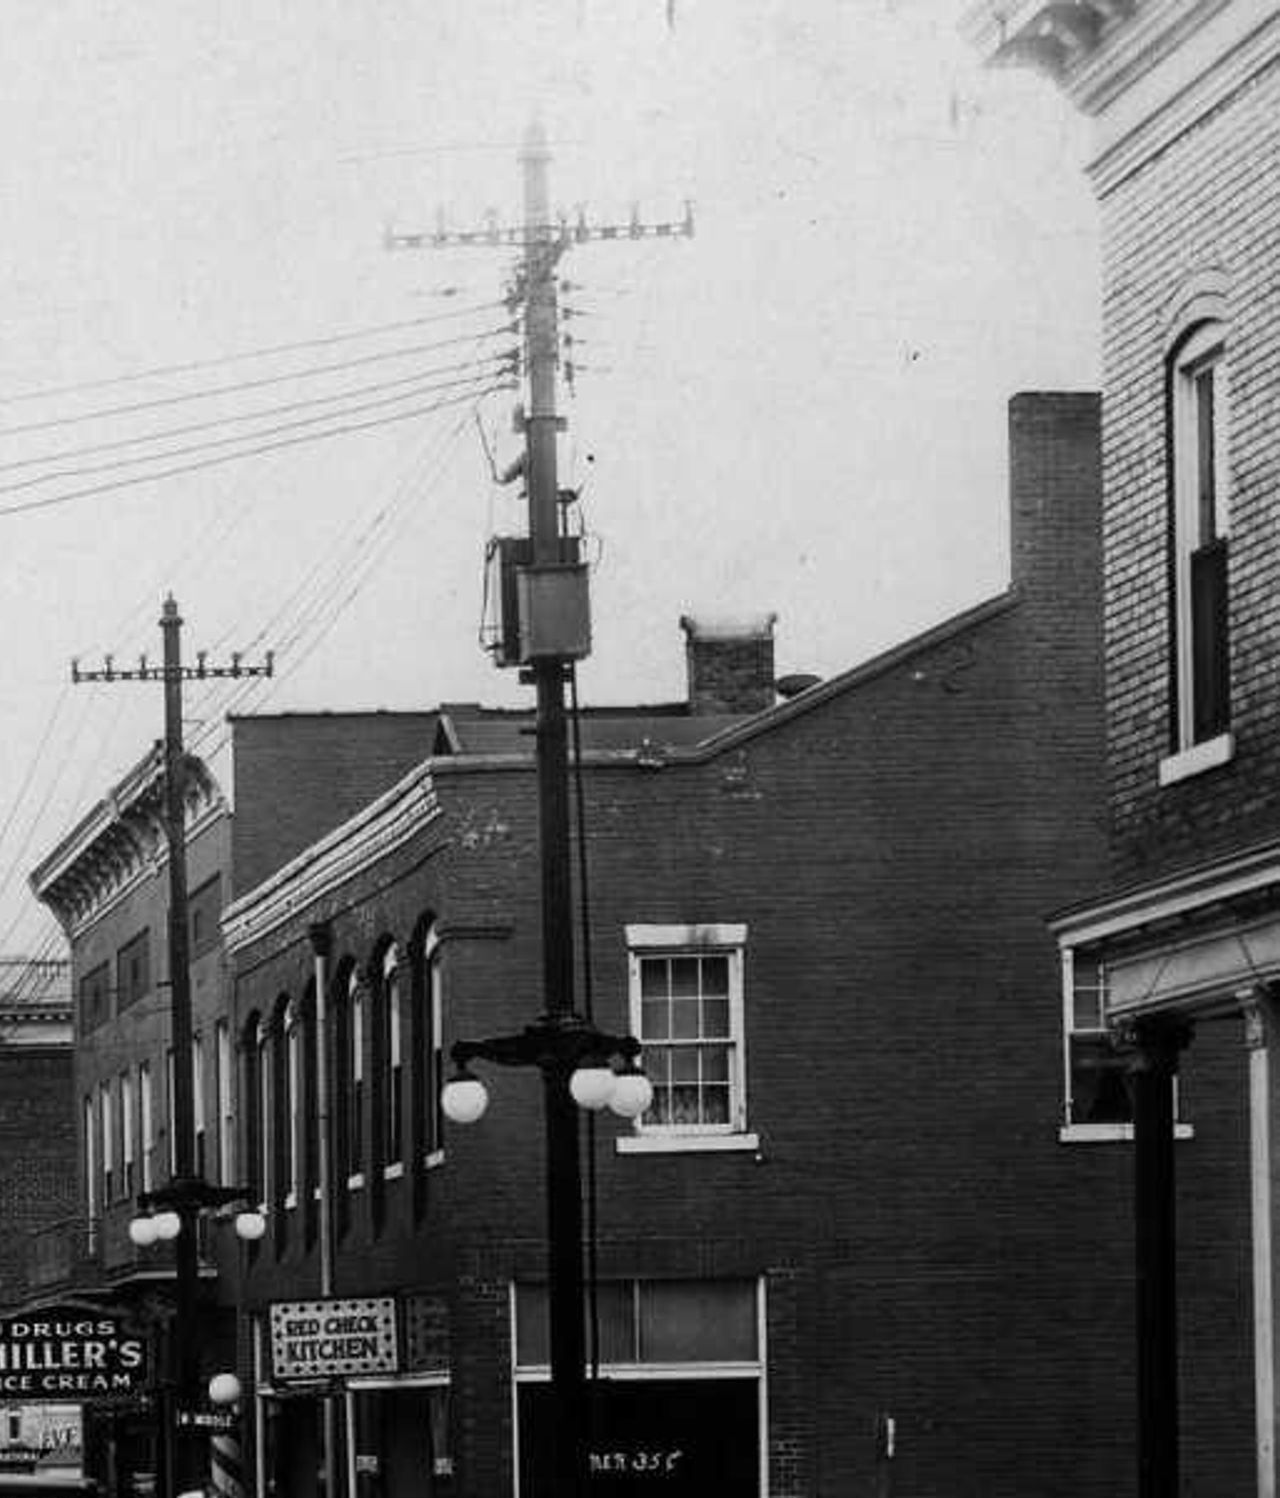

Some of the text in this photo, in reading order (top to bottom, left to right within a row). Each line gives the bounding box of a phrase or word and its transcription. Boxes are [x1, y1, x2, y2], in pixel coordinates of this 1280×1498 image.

[11, 1321, 117, 1338] DRUGS
[287, 1316, 377, 1336] RED CHECK
[288, 1338, 378, 1361] KITCHEN
[42, 1373, 132, 1392] CREAM
